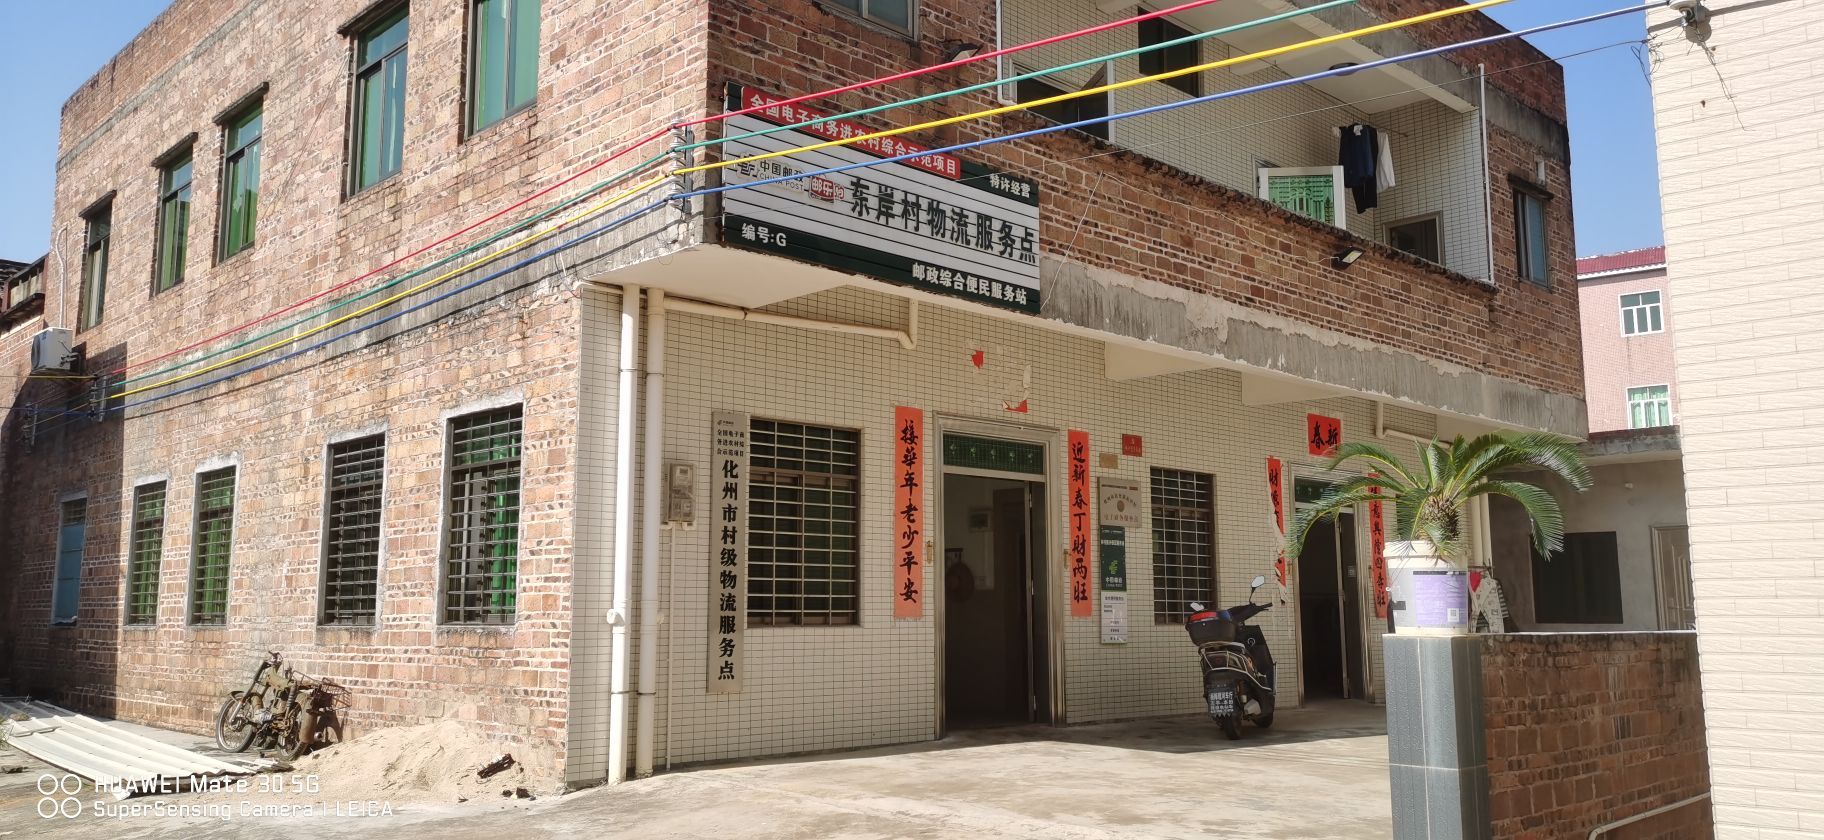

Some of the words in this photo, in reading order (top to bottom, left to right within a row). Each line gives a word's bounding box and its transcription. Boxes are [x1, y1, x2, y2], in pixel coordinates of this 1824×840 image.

[750, 94, 956, 175] 全国电子商务进农村综合示范项目
[786, 180, 804, 191] POST
[989, 173, 1030, 198] 特许经营
[850, 177, 1037, 263] 东岸村物流服务点
[912, 262, 1027, 305] 邮政综合便民服务站
[717, 460, 739, 681] 化州市村级物流服务点
